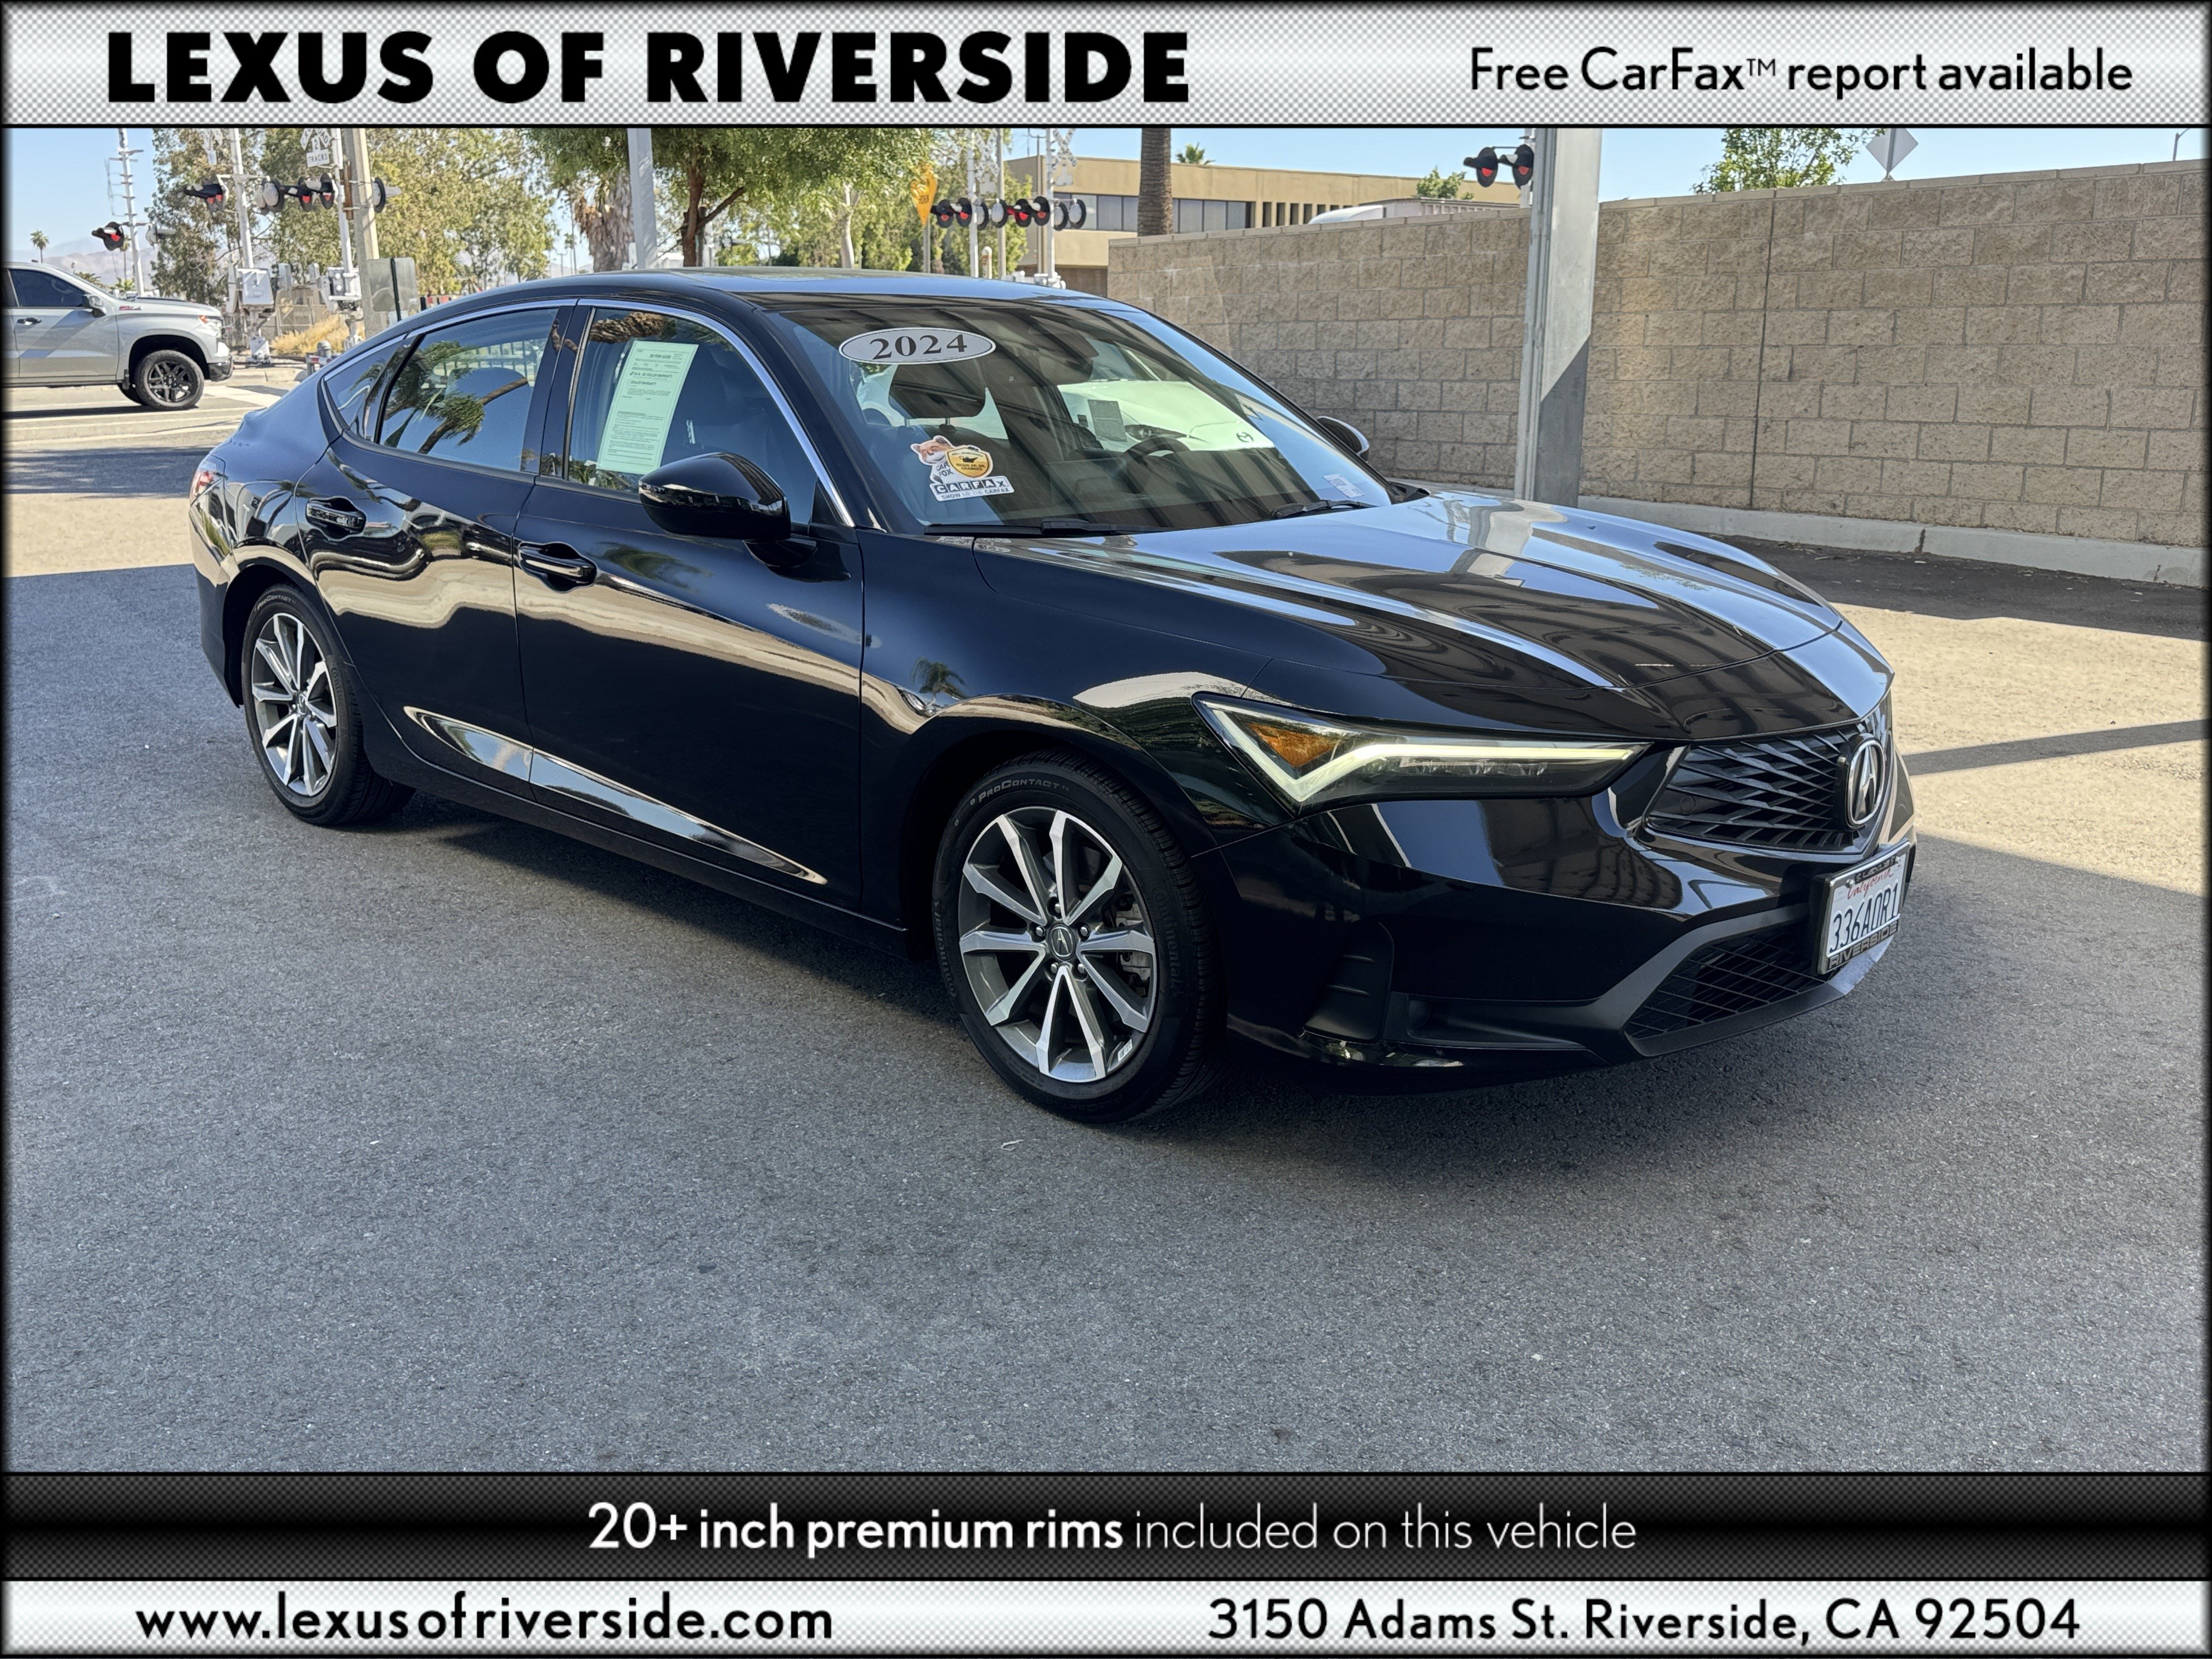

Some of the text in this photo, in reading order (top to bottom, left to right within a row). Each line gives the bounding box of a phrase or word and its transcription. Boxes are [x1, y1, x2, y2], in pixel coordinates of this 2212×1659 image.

[870, 334, 967, 360] 2024
[936, 460, 951, 472] CAR
[939, 468, 955, 478] FOX
[935, 479, 1007, 494] CARFAX
[1829, 922, 1898, 969] RIVERSIDE
